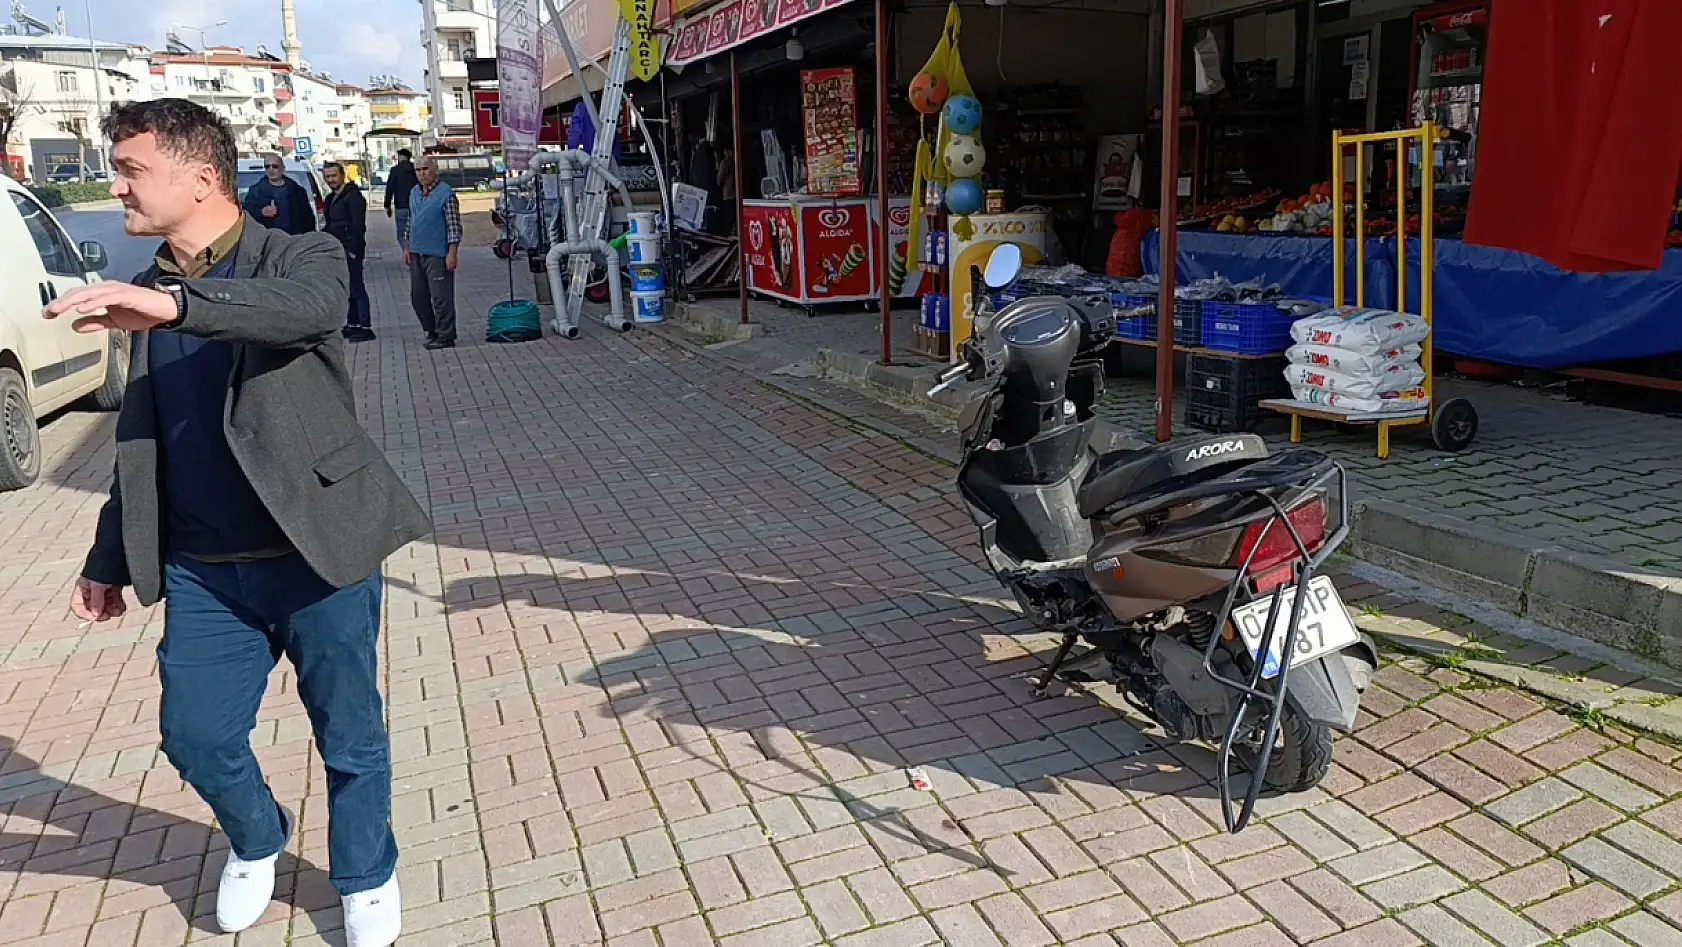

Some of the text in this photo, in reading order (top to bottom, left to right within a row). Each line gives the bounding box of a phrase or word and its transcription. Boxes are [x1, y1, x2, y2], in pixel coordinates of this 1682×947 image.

[634, 0, 650, 76] NAHTARCI
[299, 140, 308, 150] D
[1184, 439, 1245, 462] ARORA
